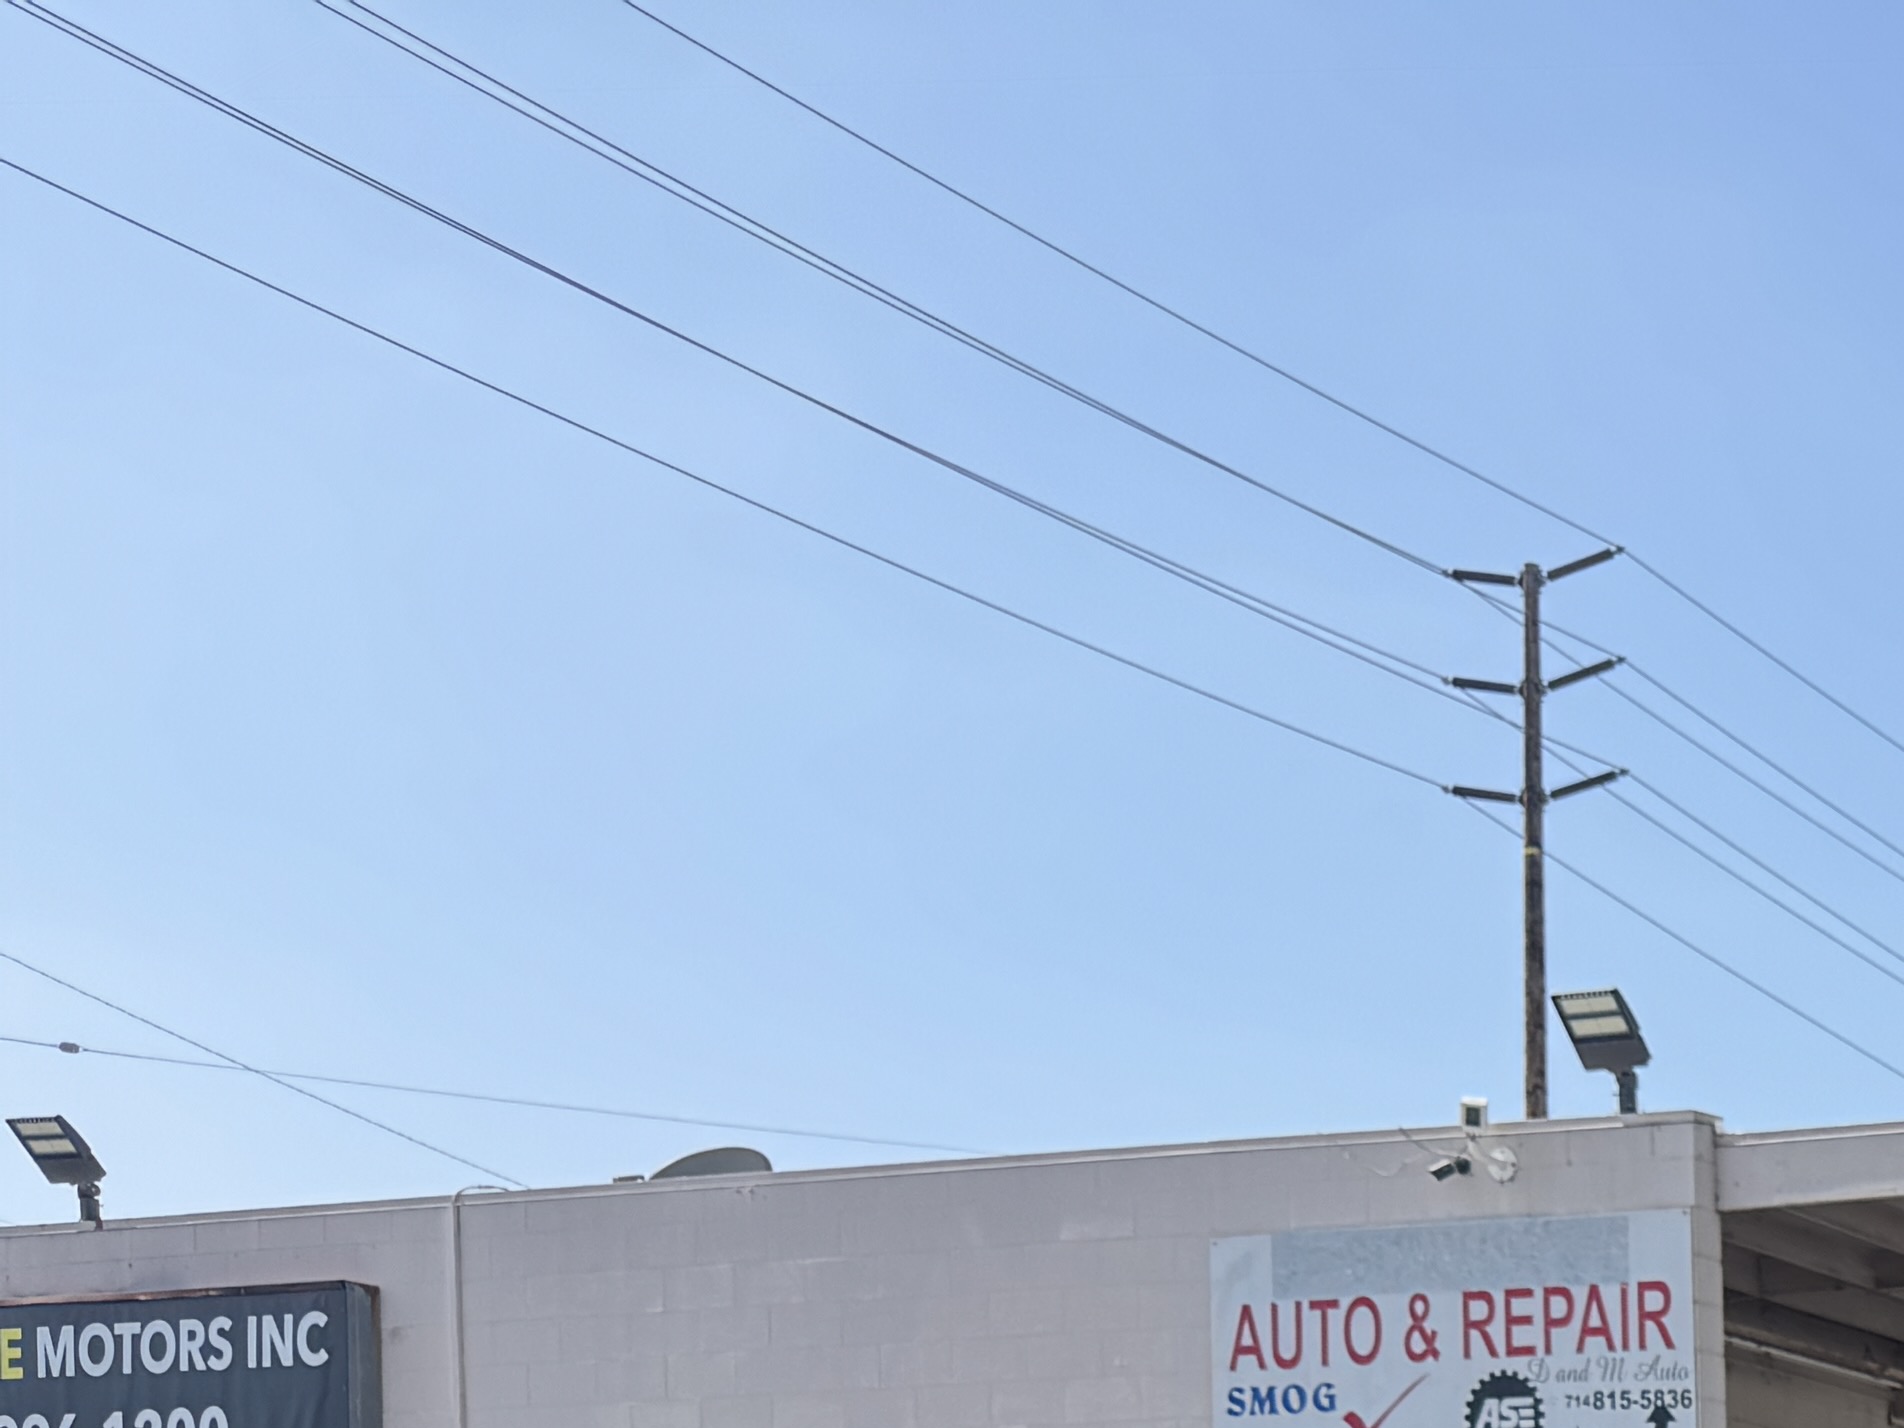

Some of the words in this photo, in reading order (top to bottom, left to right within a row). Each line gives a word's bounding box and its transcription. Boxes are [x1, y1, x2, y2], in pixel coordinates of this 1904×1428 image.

[37, 1316, 232, 1378] MOTORS
[247, 1311, 329, 1368] INC
[1229, 1296, 1383, 1370] AUTO
[1404, 1292, 1441, 1363] &
[1462, 1281, 1676, 1360] REPAIR
[1555, 1356, 1591, 1383] and
[1633, 1354, 1690, 1382] Auto
[1226, 1382, 1336, 1417] SMOG
